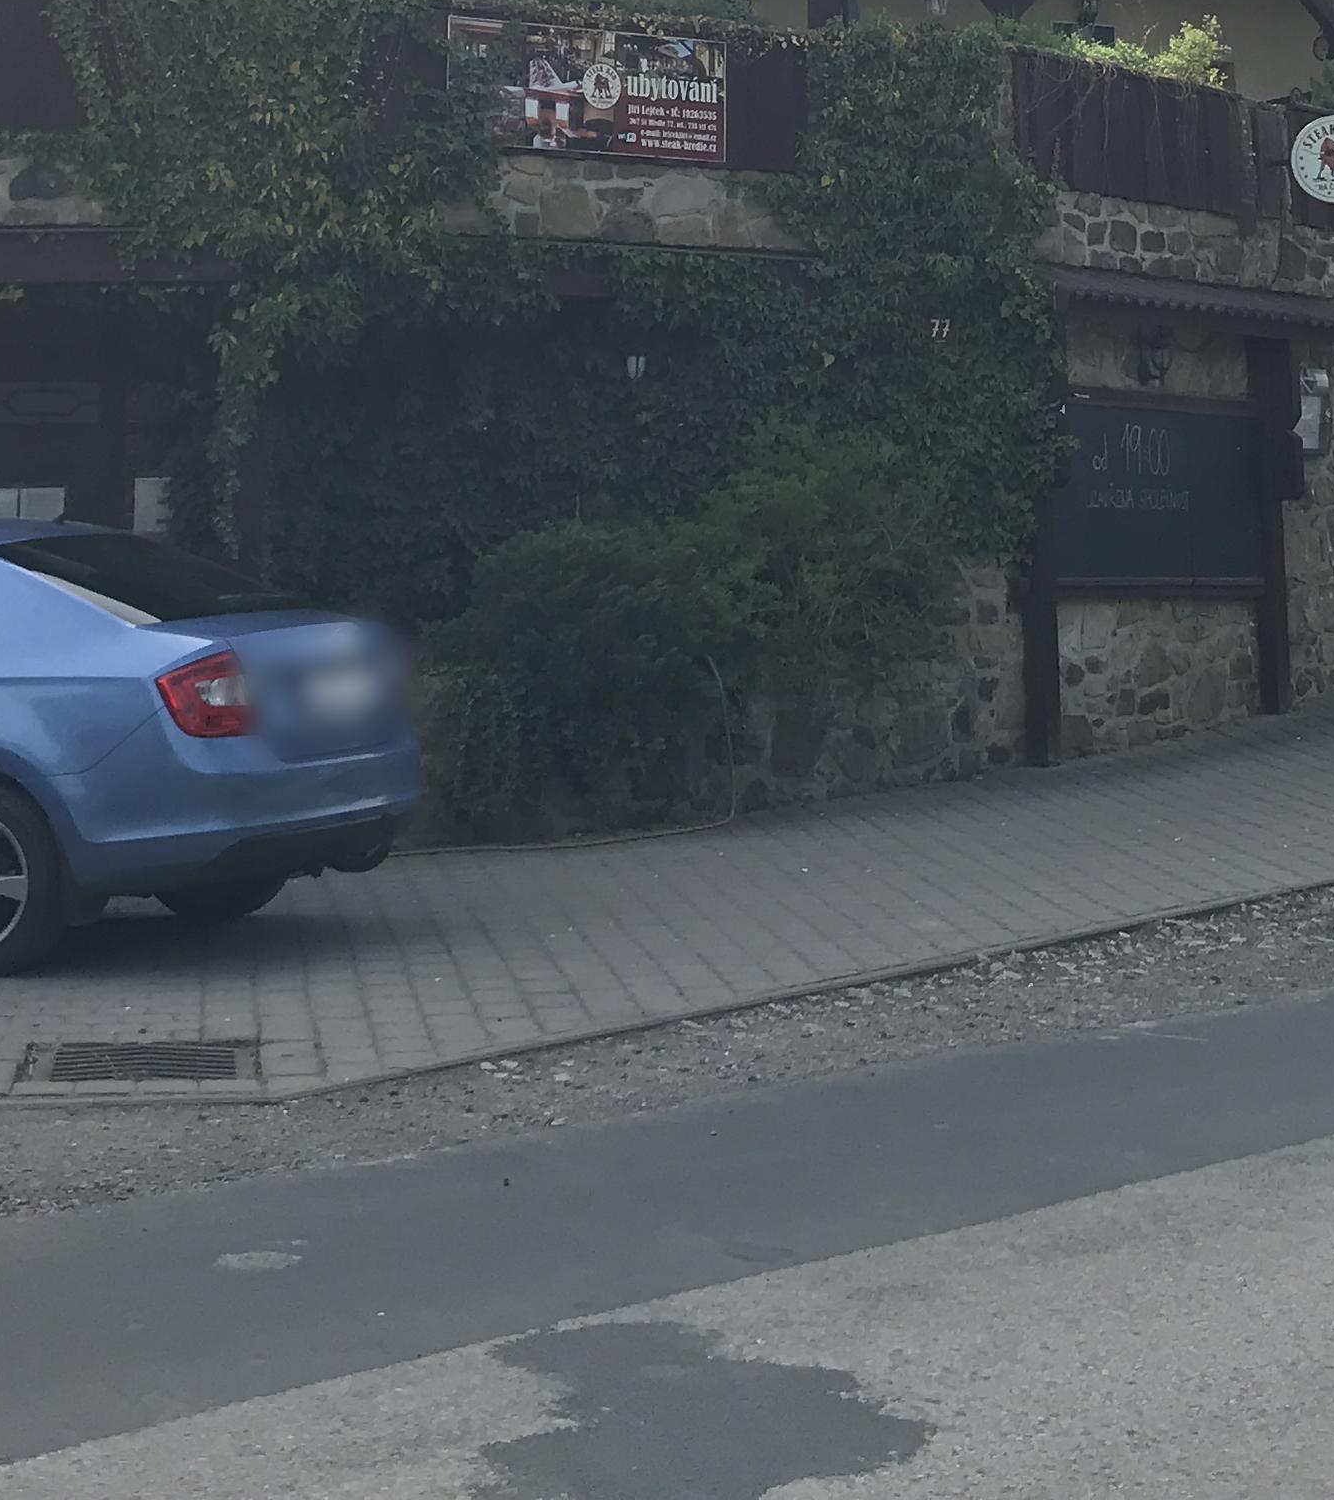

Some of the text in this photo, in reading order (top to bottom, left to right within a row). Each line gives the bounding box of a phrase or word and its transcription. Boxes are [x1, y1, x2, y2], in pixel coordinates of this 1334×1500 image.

[627, 73, 718, 103] ubytování
[930, 318, 951, 338] 77
[1092, 422, 1170, 477] od 19:00
